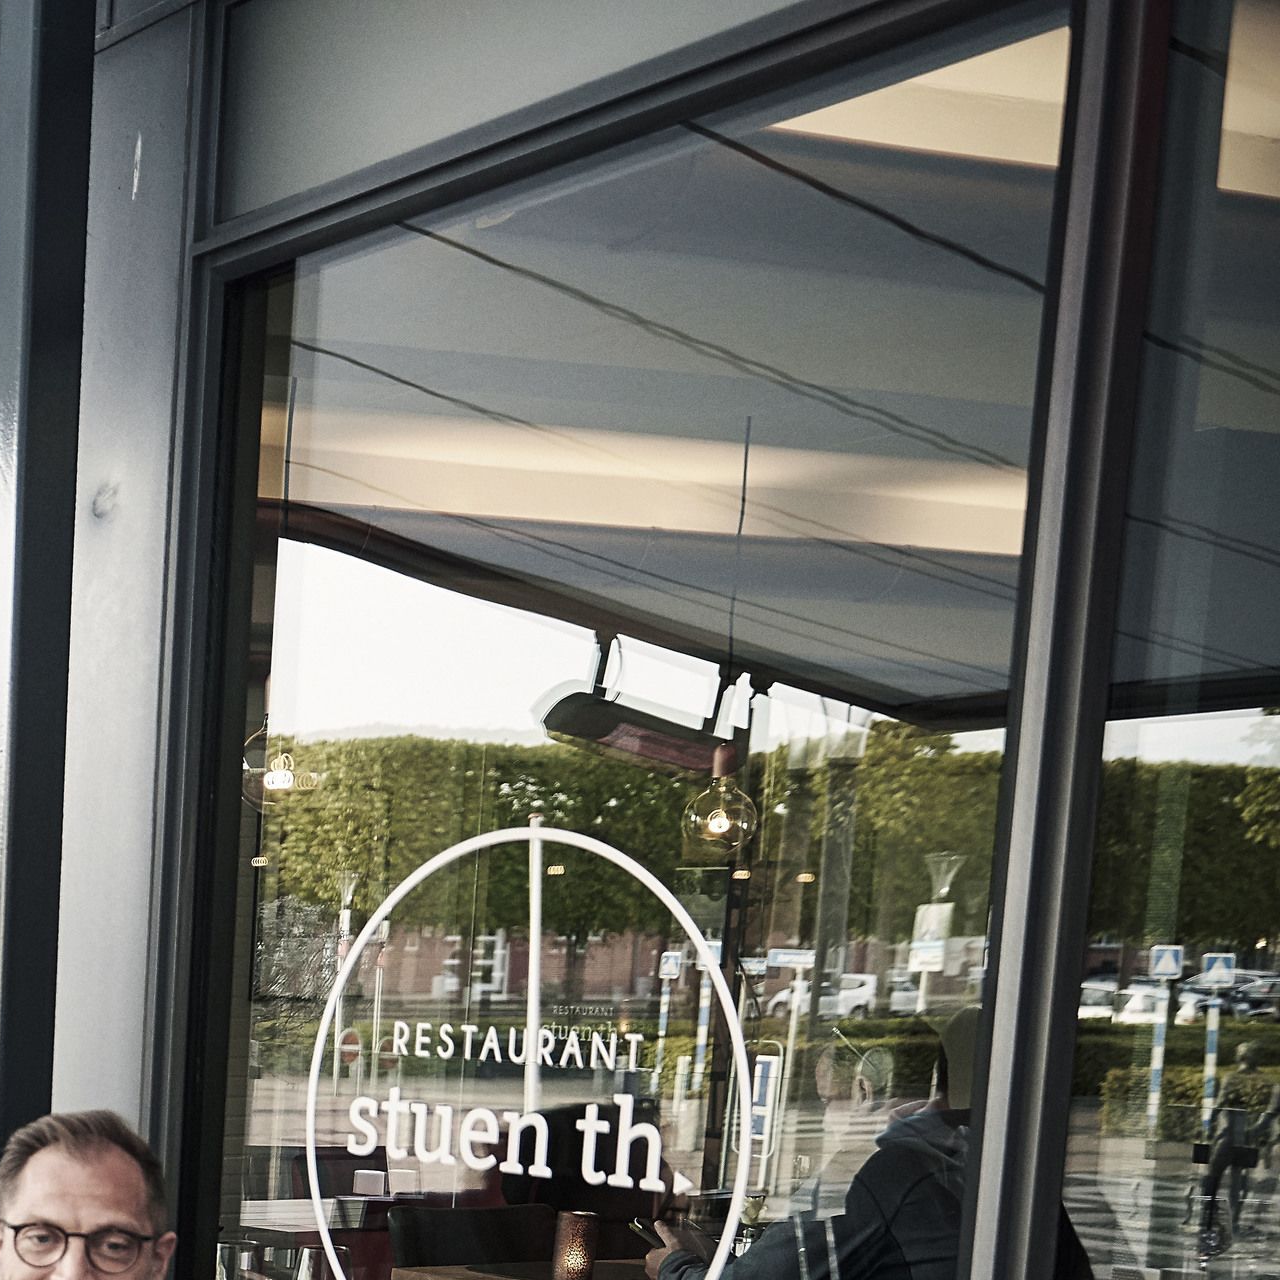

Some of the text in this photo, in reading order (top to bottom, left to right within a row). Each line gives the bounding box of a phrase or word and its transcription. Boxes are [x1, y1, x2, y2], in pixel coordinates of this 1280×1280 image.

[552, 1005, 615, 1017] RESTAURANT
[392, 1020, 645, 1073] RESTAURANT
[346, 1086, 553, 1179] stuen
